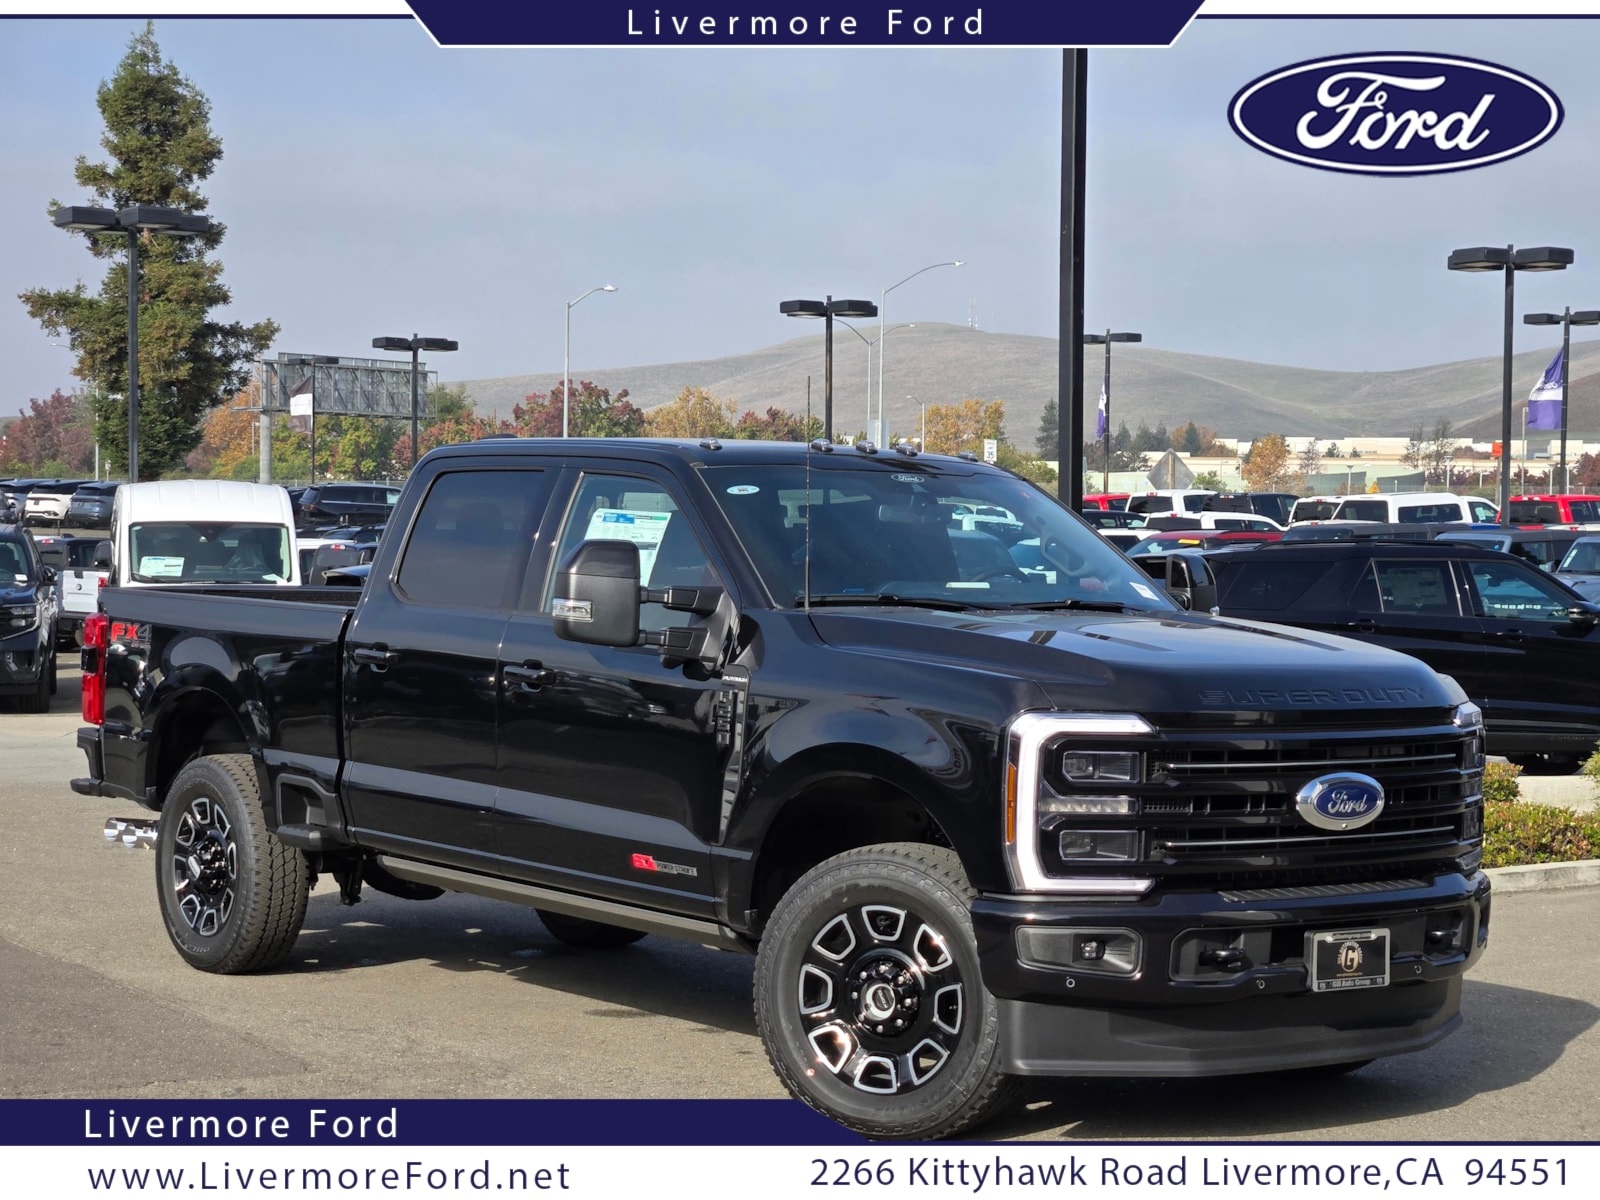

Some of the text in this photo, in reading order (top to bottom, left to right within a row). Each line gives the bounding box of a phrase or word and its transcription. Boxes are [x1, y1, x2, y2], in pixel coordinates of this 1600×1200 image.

[986, 450, 995, 459] 35
[111, 621, 152, 643] FX4
[1198, 687, 1425, 706] SUPER DUTY
[1328, 789, 1368, 814] Ford
[1342, 979, 1355, 987] Auto
[1355, 978, 1371, 988] Group
